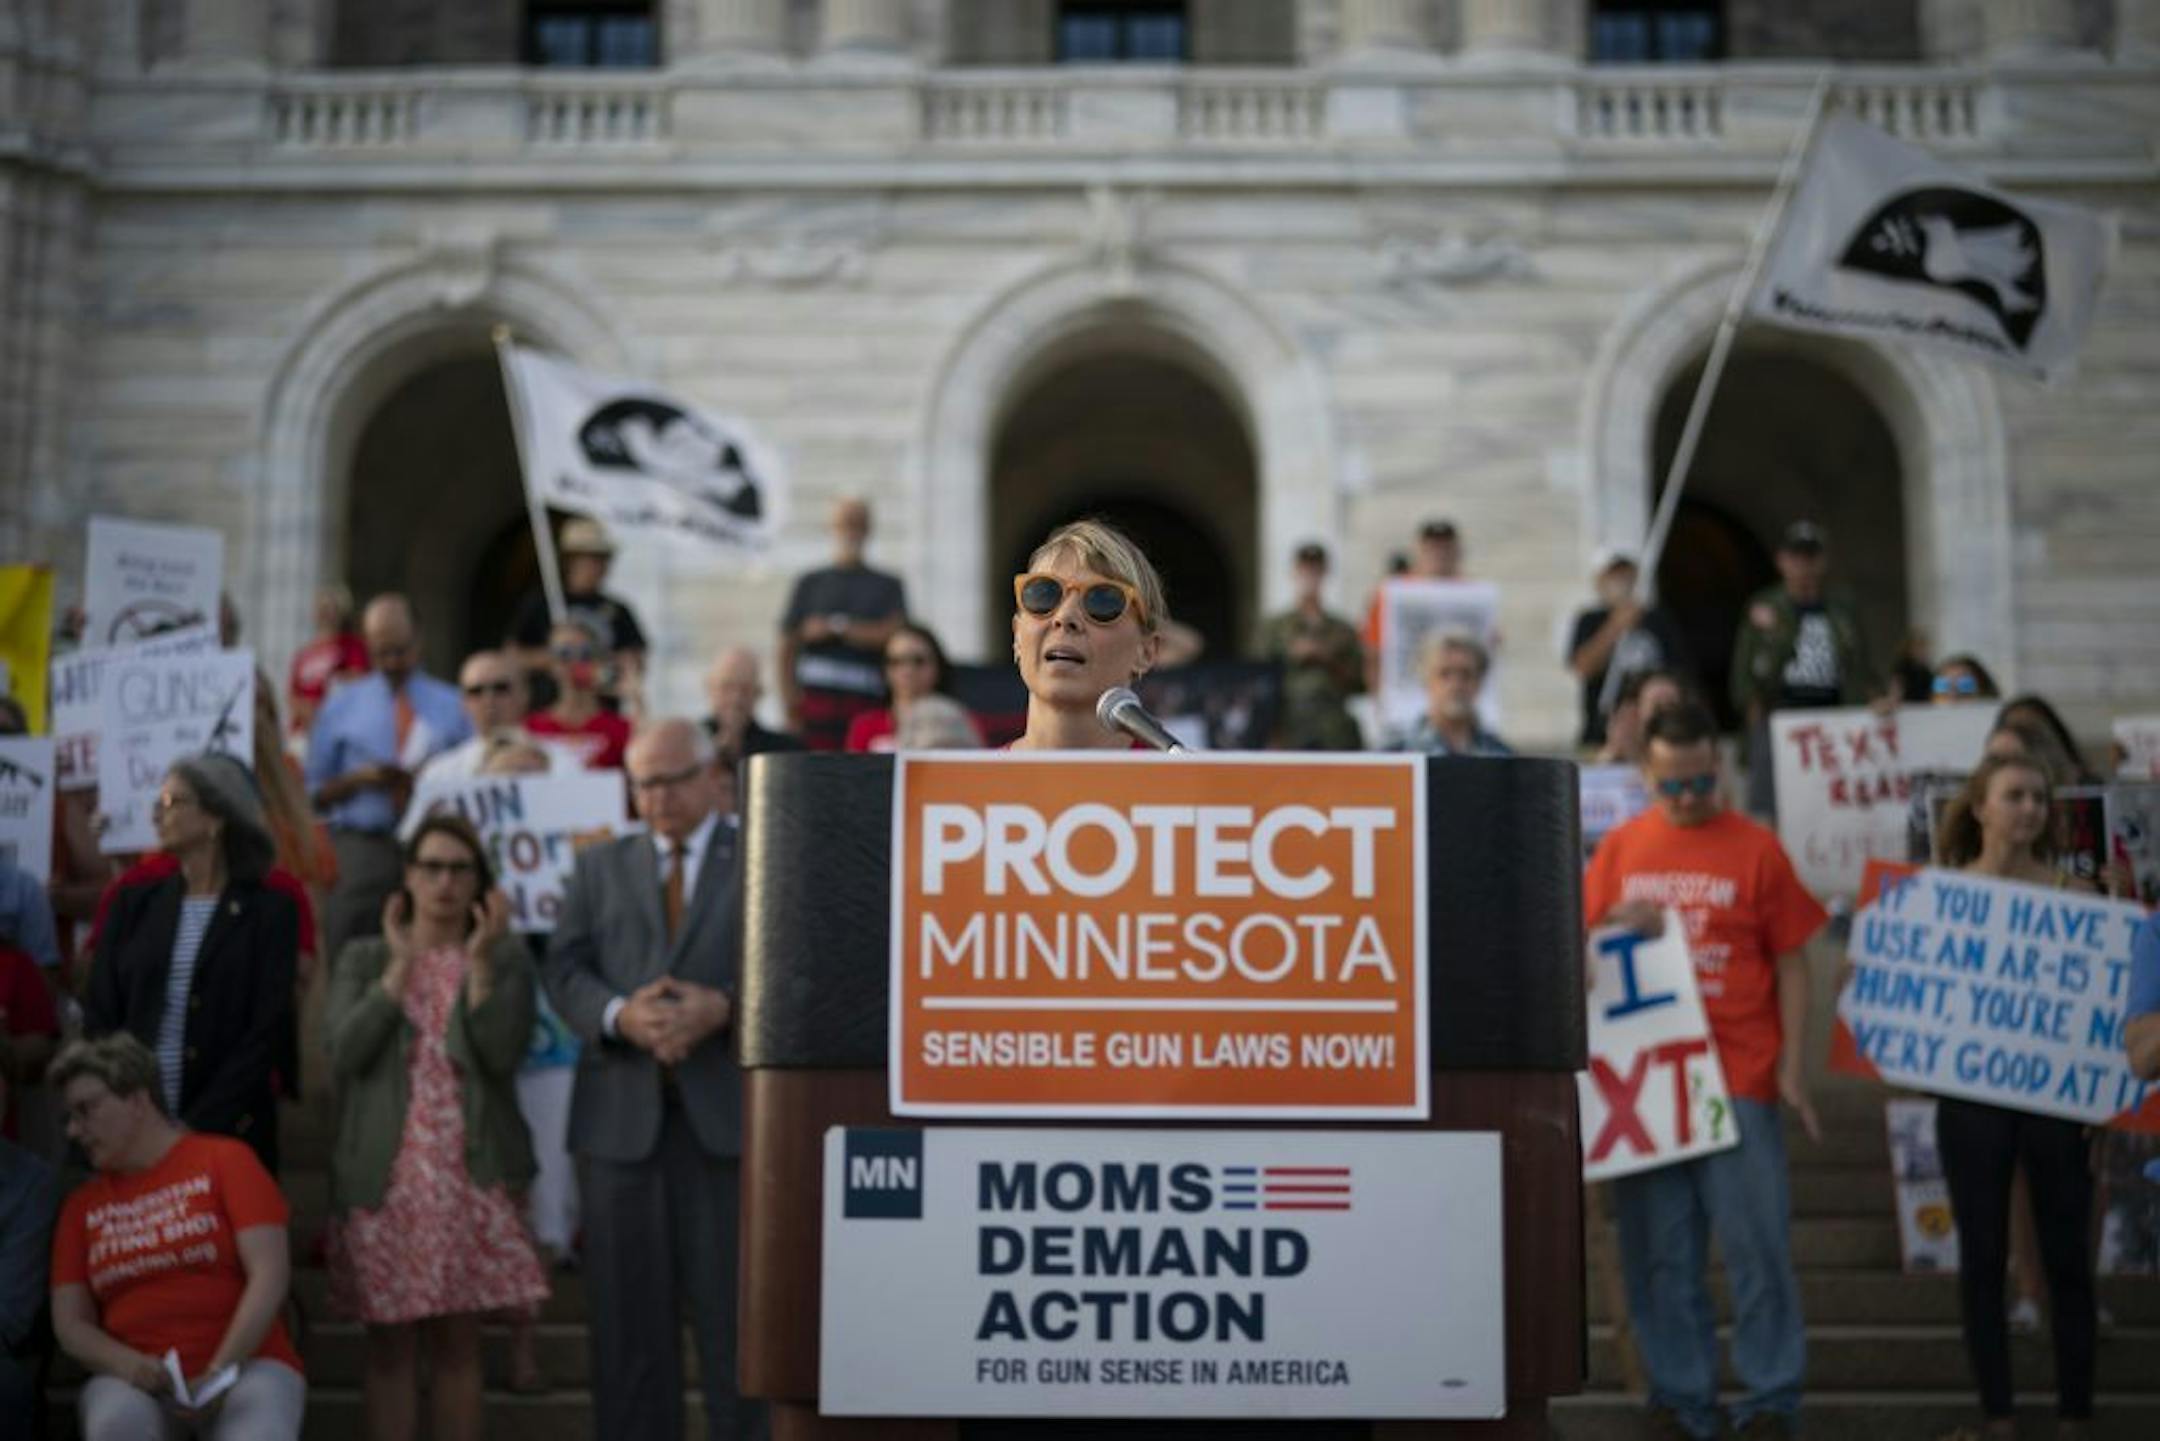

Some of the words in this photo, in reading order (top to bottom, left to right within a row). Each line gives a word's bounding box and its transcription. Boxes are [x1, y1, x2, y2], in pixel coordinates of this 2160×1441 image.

[920, 803, 1397, 900] PROTECT
[1879, 873, 1920, 912] IF
[1934, 882, 1993, 928] YOU
[2009, 895, 2108, 950] HAVE
[920, 912, 1397, 983] MINNESOTA
[1864, 916, 1929, 964] USE
[1936, 929, 1988, 973] AN
[1998, 944, 2090, 993] AR-15
[1853, 962, 1956, 1025] HUNT,
[1968, 983, 2075, 1044] YOU'RE
[923, 1031, 1095, 1067] SENSIBLE
[1105, 1032, 1183, 1068] GUN
[1192, 1034, 1291, 1068] LAWS
[1301, 1034, 1395, 1069] NOW!
[1854, 1017, 1946, 1075] VERY
[1954, 1039, 2053, 1093] GOOD
[2055, 1062, 2110, 1107] AT
[850, 1156, 917, 1190] MN
[977, 1162, 1214, 1214] MOMS
[977, 1226, 1311, 1278] DEMAND
[976, 1290, 1266, 1343] ACTION
[977, 1358, 1027, 1384] FOR
[1037, 1359, 1091, 1385] GUN
[1101, 1359, 1182, 1385] SENSE
[1192, 1361, 1217, 1385] IN
[1227, 1360, 1350, 1386] AMERICA
